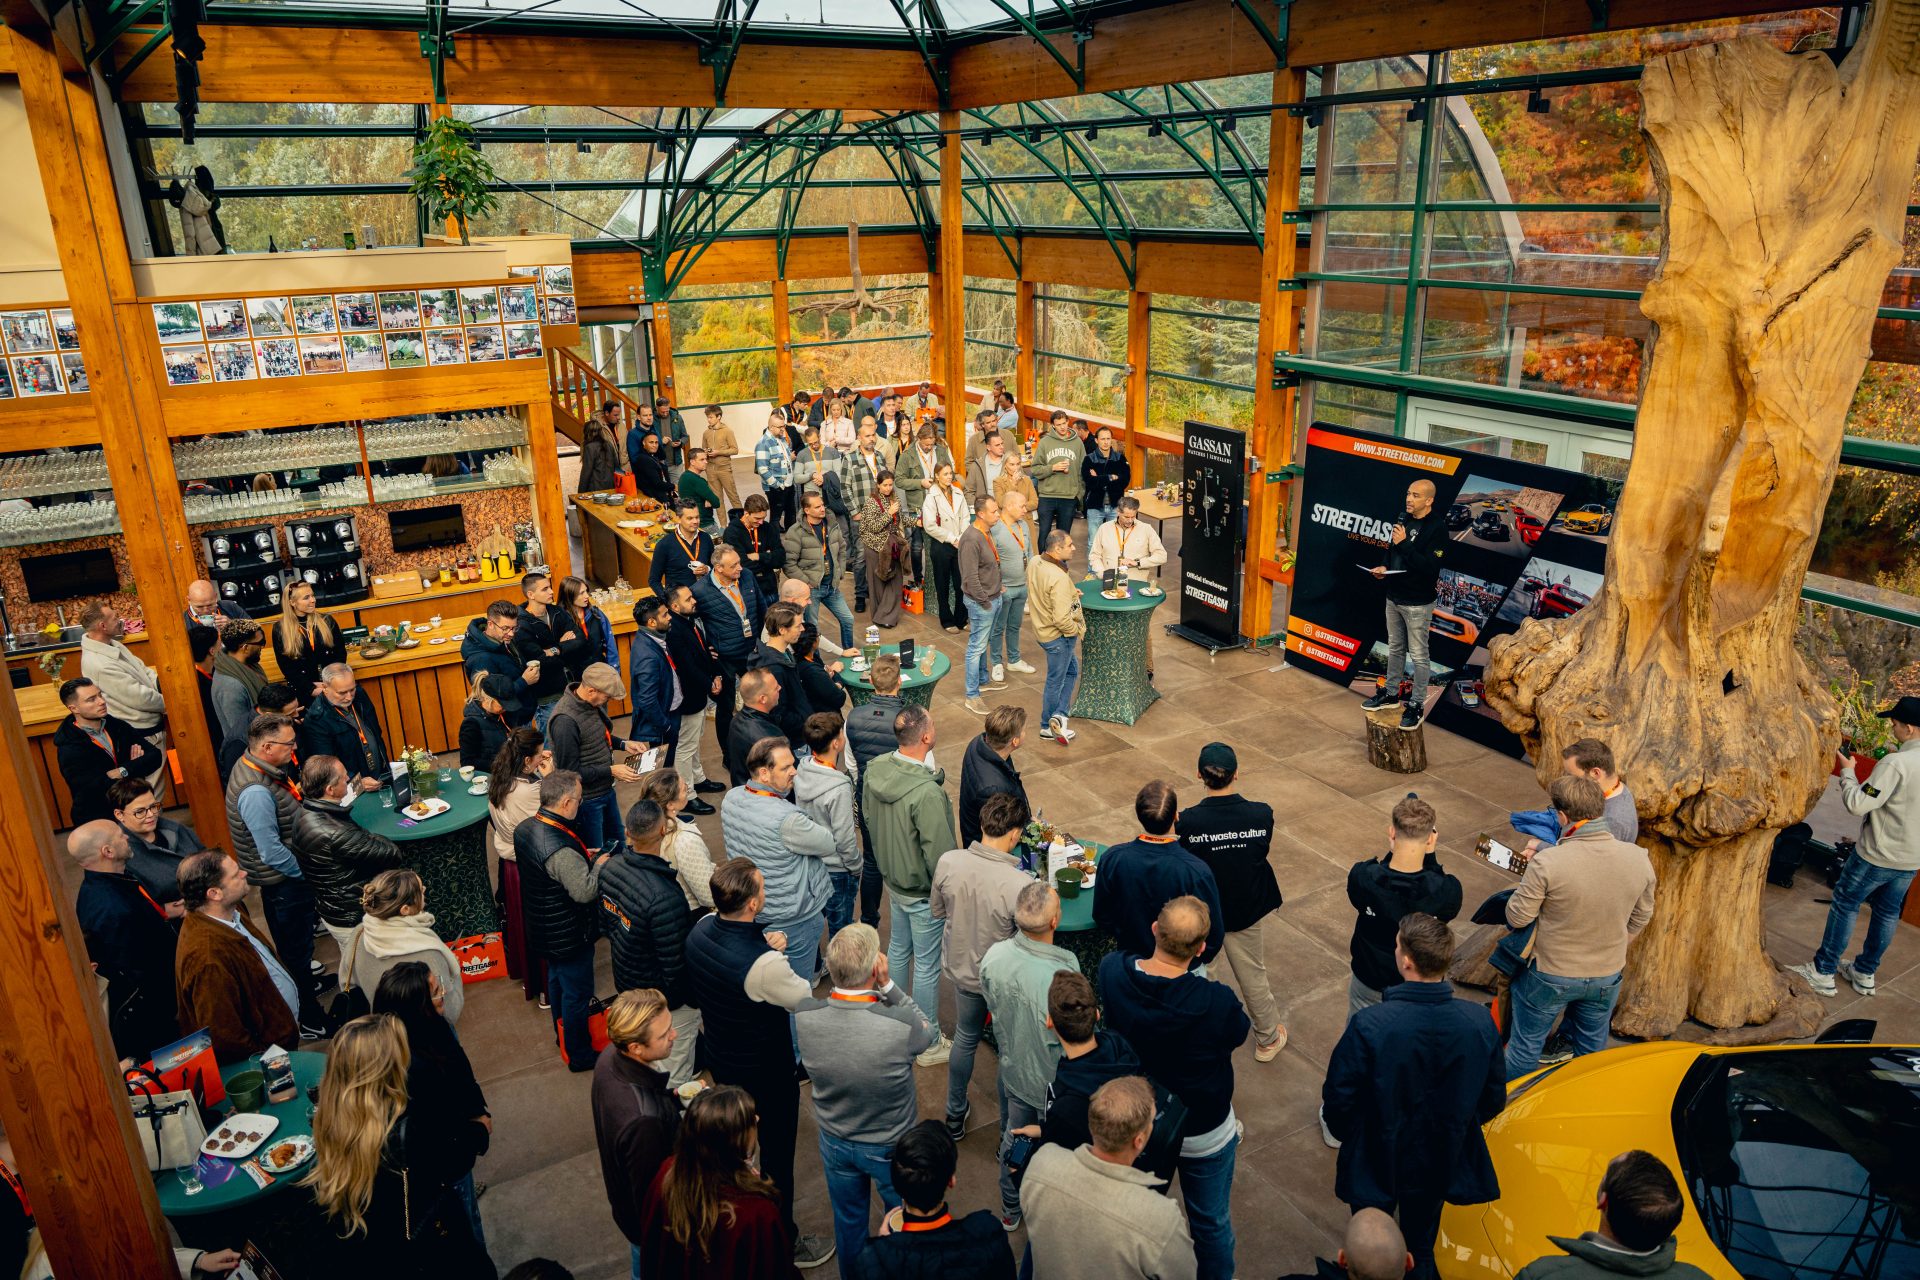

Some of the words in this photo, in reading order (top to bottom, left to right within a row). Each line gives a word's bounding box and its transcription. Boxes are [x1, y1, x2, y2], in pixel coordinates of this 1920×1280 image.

[1189, 435, 1231, 457] GASSAN
[1353, 441, 1446, 469] WWW.STREETGASM.COM
[1195, 469, 1202, 481] 11
[1204, 466, 1213, 479] 12
[1187, 478, 1196, 490] 10
[1186, 492, 1193, 503] 9
[1188, 505, 1195, 516] 8
[1223, 503, 1231, 514] 3
[1194, 518, 1201, 529] 7
[1220, 516, 1227, 527] 4
[1311, 502, 1394, 543] STREETGAS
[1214, 525, 1221, 537] 5
[1360, 536, 1376, 546] YOUR
[1377, 540, 1390, 550] DRE
[1186, 571, 1203, 583] Official
[1202, 577, 1228, 592] timekeeper
[1185, 585, 1229, 610] STREETGASM
[1315, 629, 1355, 650] @STREETGASM
[1306, 646, 1346, 667] @STREETGASM
[1188, 833, 1209, 843] don't
[1209, 831, 1238, 842] waste
[1239, 828, 1267, 839] culture
[460, 959, 498, 973] TREETGASM
